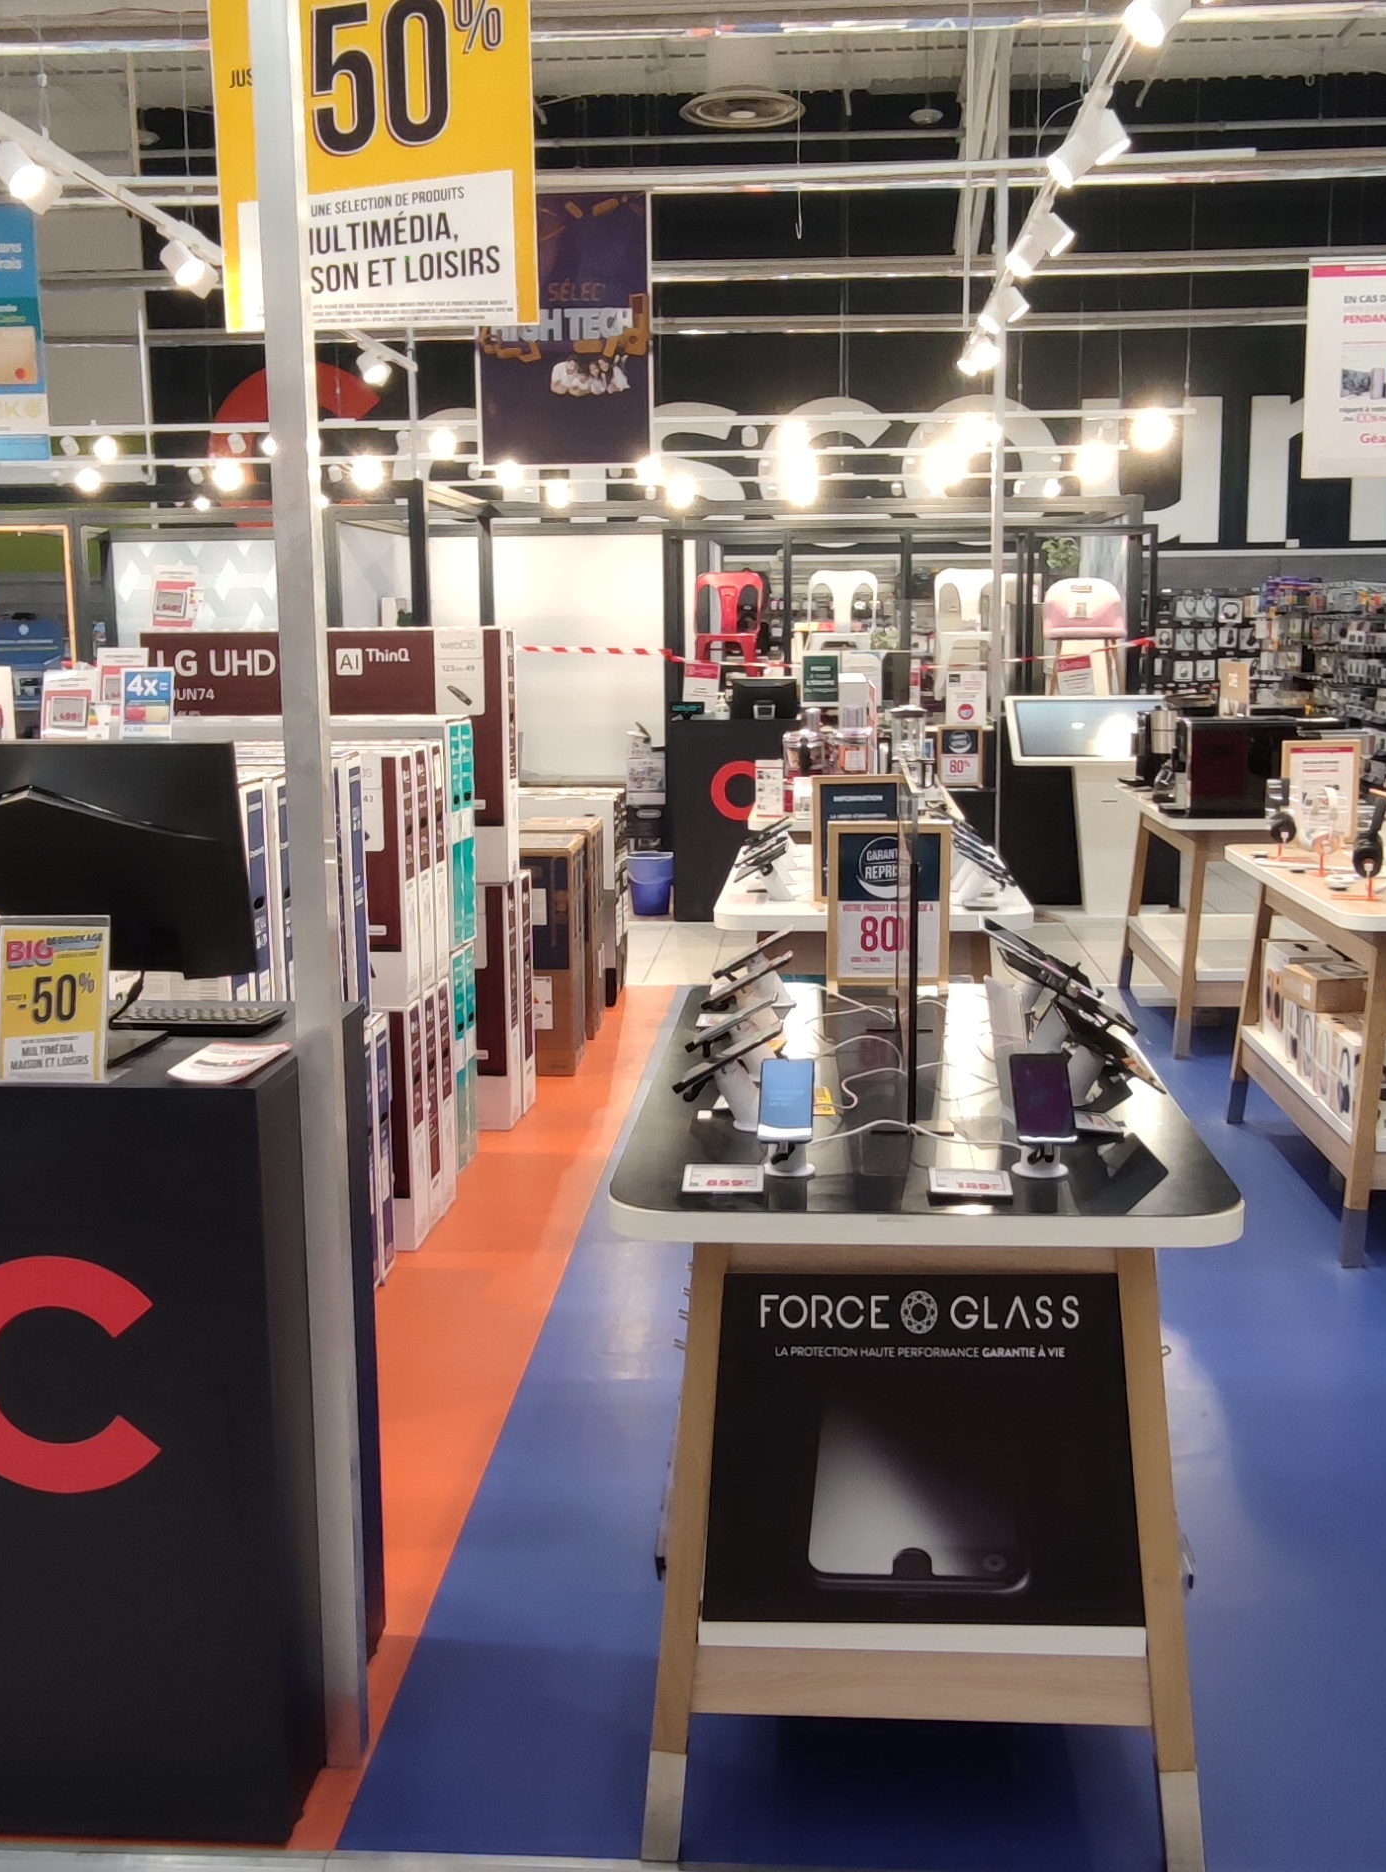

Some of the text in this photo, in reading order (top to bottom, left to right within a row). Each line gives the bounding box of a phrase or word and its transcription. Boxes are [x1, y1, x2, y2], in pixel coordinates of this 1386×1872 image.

[311, 186, 465, 217] UNE SÉLECTION DE PRODUITS
[367, 257, 397, 288] ET
[404, 245, 501, 284] LOISIRS
[1343, 295, 1357, 304] EN
[1359, 294, 1378, 303] CAS
[209, 649, 276, 677] UHD
[340, 648, 411, 670] AI ThinQ
[6, 939, 53, 964] BIG
[759, 1294, 1081, 1331] FORCE GLASS
[774, 1343, 1065, 1359] LA PROTECTION HAUTE PERFORMANCE GARANTIE À VIE
